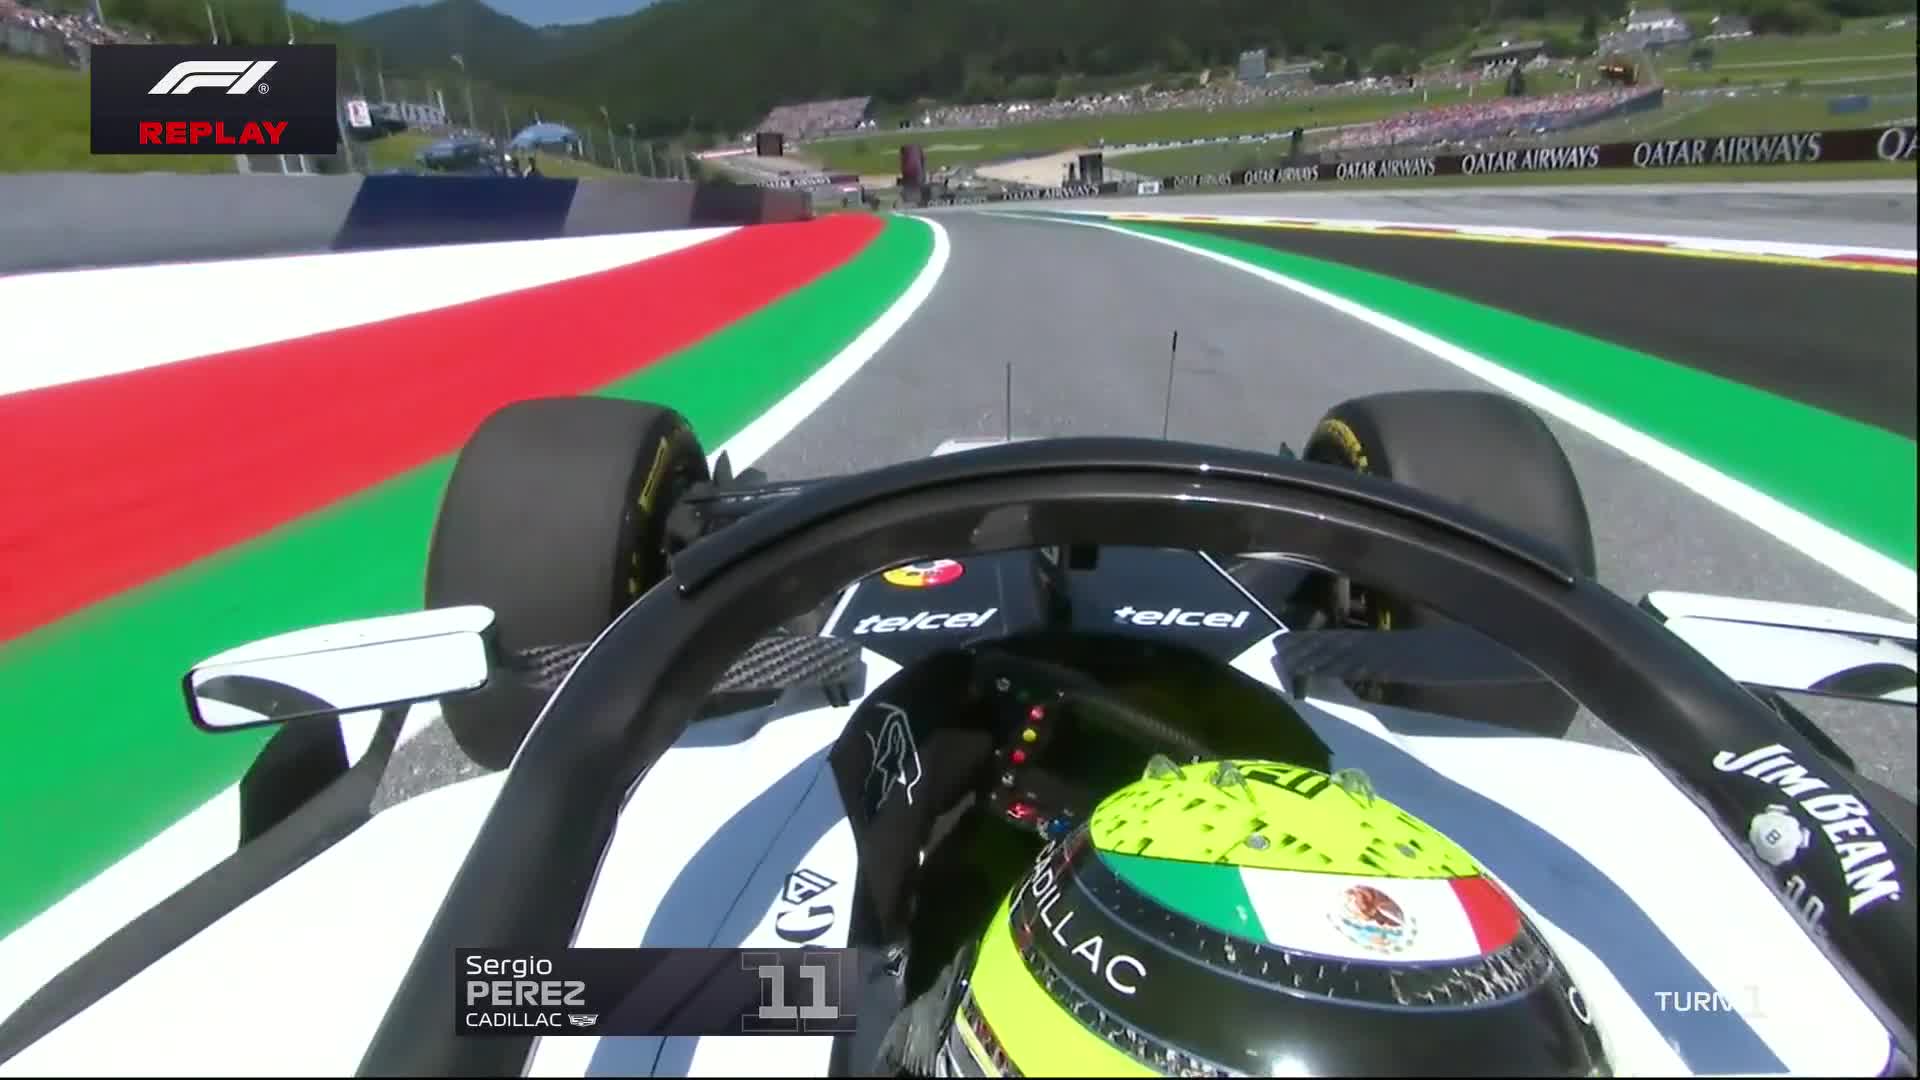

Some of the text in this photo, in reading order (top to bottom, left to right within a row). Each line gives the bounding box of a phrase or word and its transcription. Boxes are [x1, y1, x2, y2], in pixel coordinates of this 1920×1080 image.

[1462, 145, 1600, 175] QATAR AIRWAYS
[1633, 132, 1823, 168] QATAR AIRWAYS
[1336, 157, 1436, 181] QATAR AIRWAYS
[853, 607, 998, 635] telcel
[1114, 605, 1251, 629] telcel
[1713, 744, 1900, 915] JIM BEAM
[1034, 839, 1147, 995] CADILLAC
